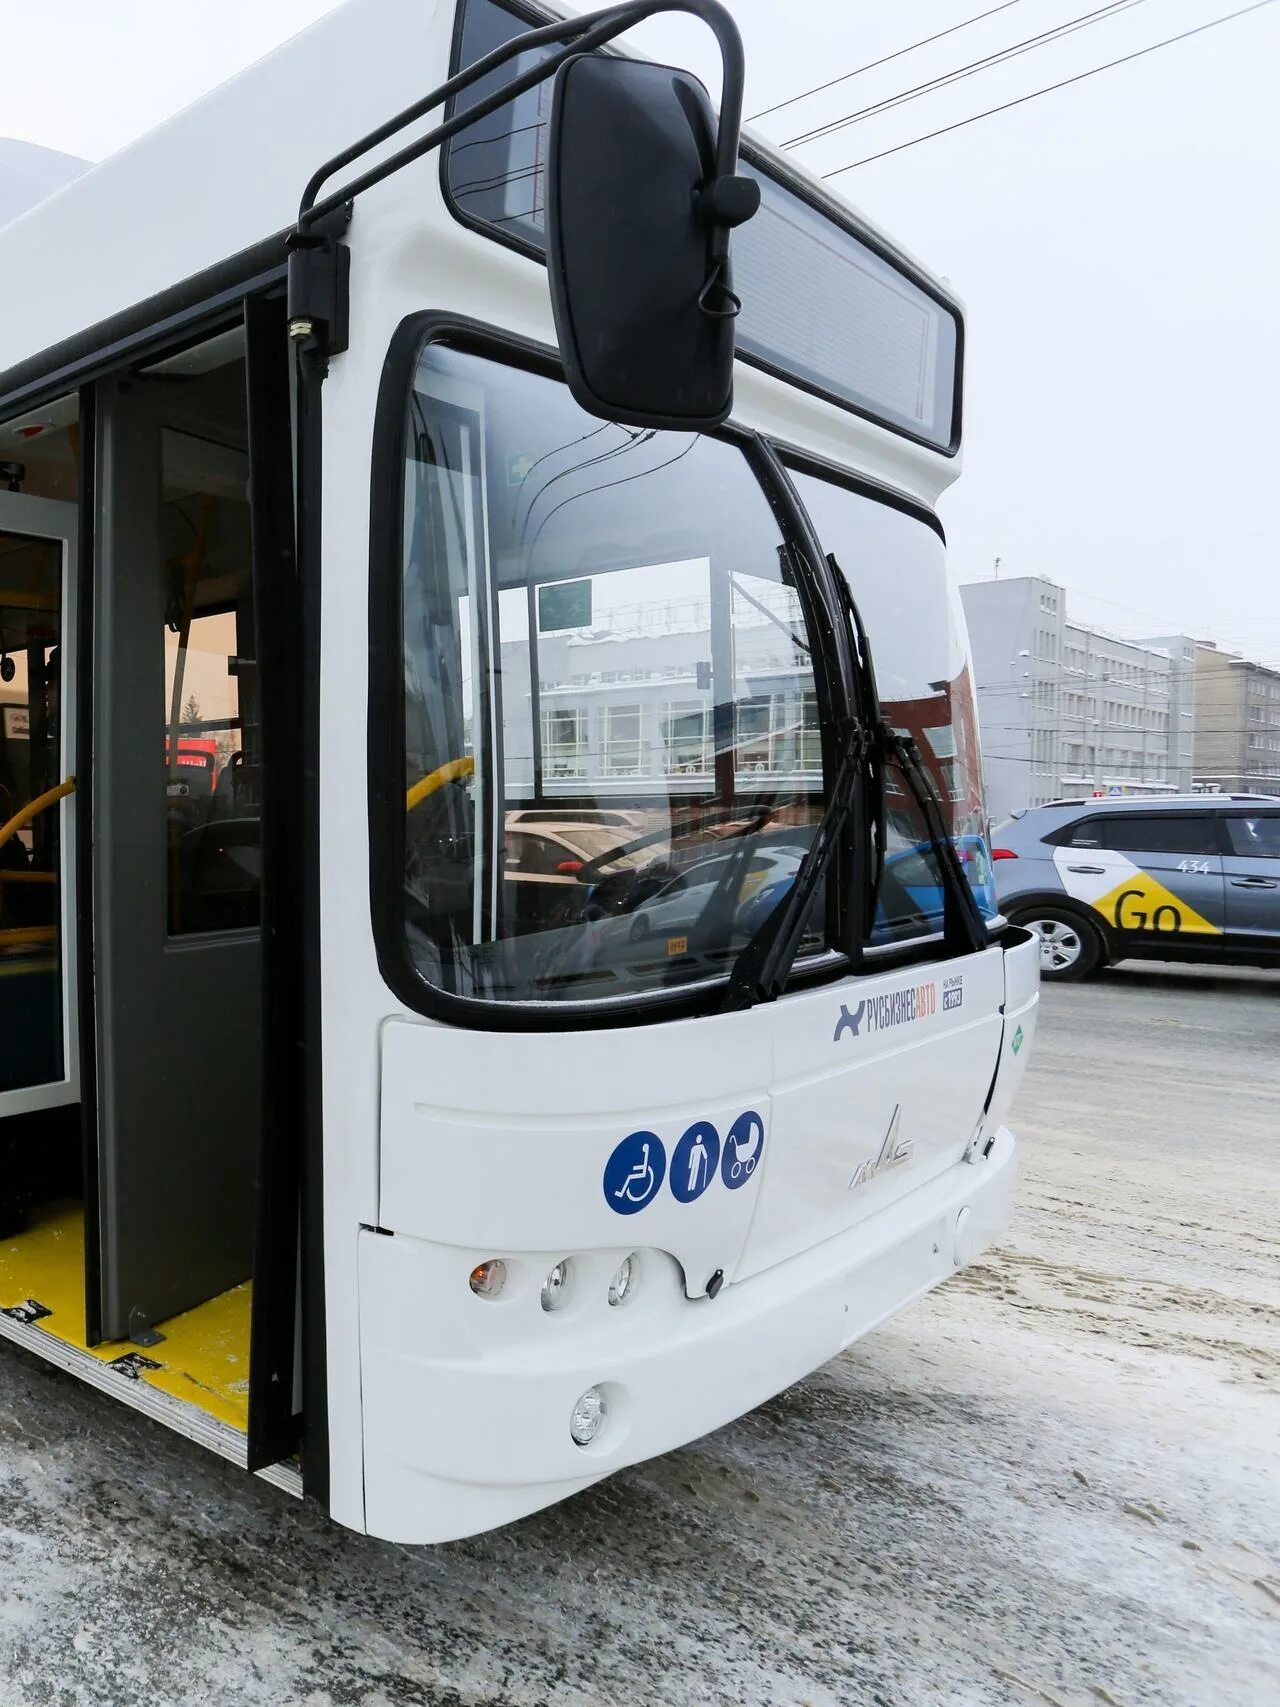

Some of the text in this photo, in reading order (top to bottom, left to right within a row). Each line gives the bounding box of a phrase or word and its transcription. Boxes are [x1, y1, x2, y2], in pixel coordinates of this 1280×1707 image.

[1176, 860, 1209, 875] 434
[1114, 890, 1182, 932] Go
[867, 983, 936, 1032] РУСБИЗНЕСАВТО
